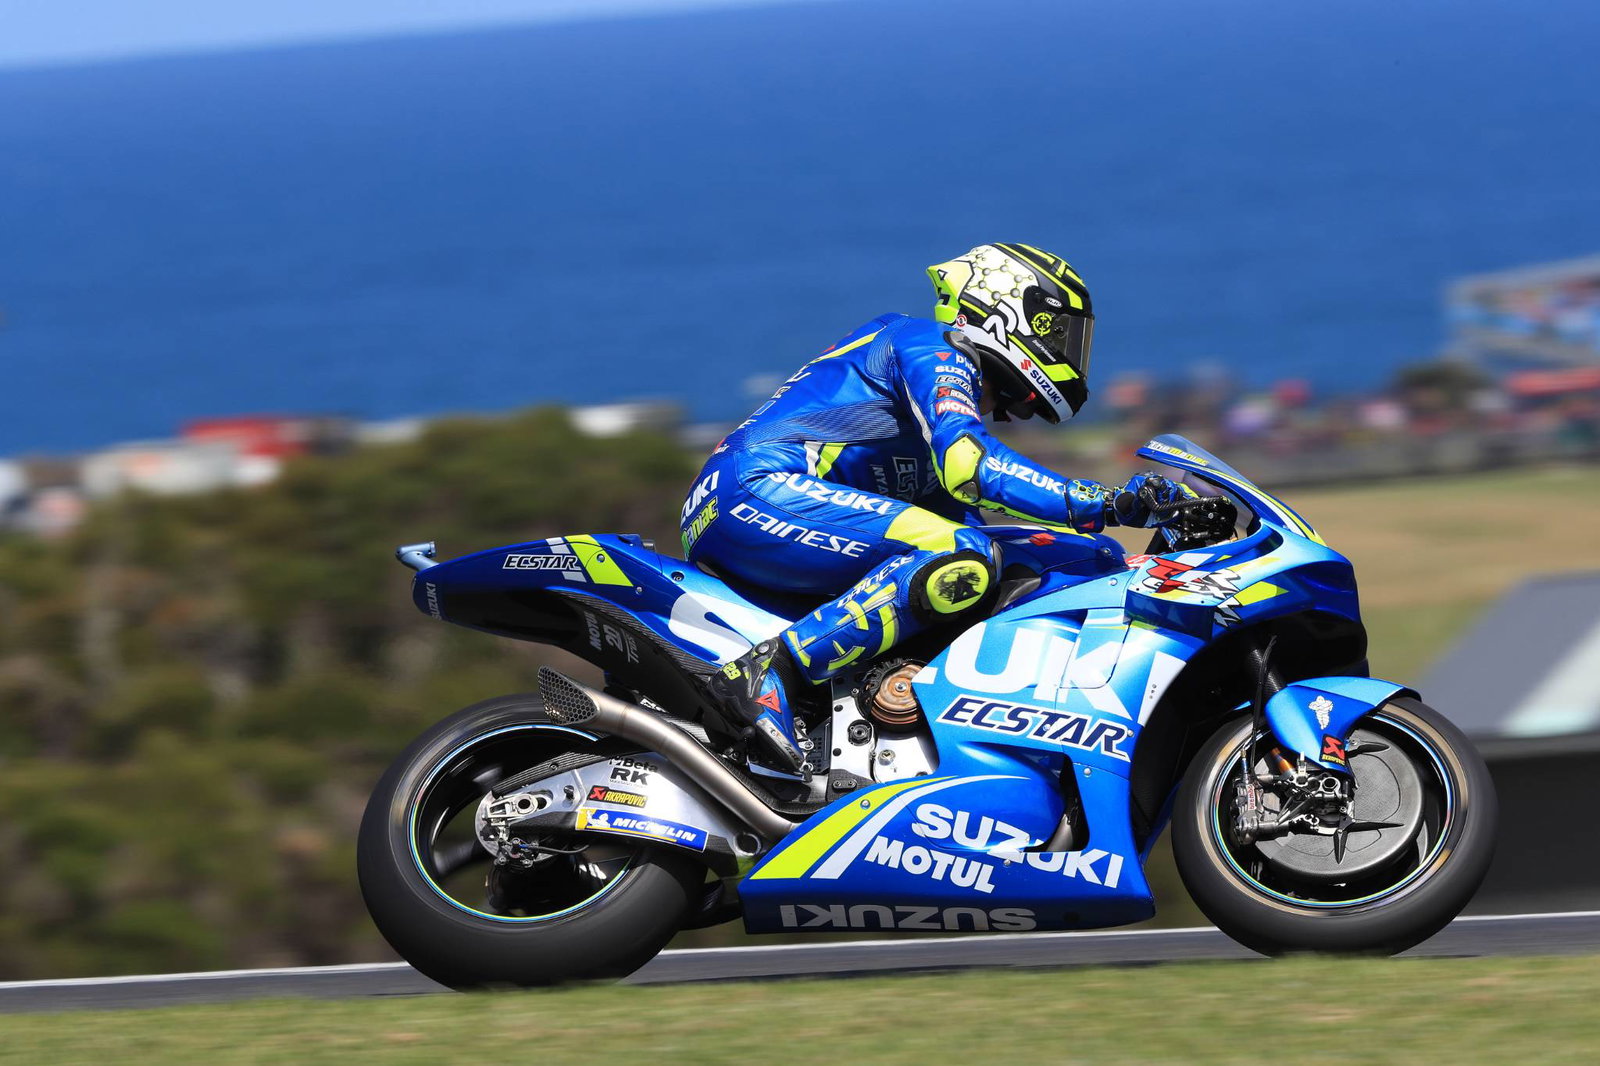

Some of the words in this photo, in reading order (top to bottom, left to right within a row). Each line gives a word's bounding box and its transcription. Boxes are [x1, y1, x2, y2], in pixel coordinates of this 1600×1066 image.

[1030, 369, 1062, 405] SUZUKI
[769, 471, 895, 515] SUZUKI
[729, 502, 870, 558] DAINESE
[503, 554, 582, 571] ECSTAR
[836, 555, 914, 608] DAINESE
[426, 582, 442, 620] SUZUKI
[938, 696, 1131, 761] ECSTAR
[610, 767, 651, 786] RK
[864, 836, 996, 894] MOTUL
[911, 803, 1124, 888] SUZUKI
[779, 904, 1037, 931] SUZUKI
